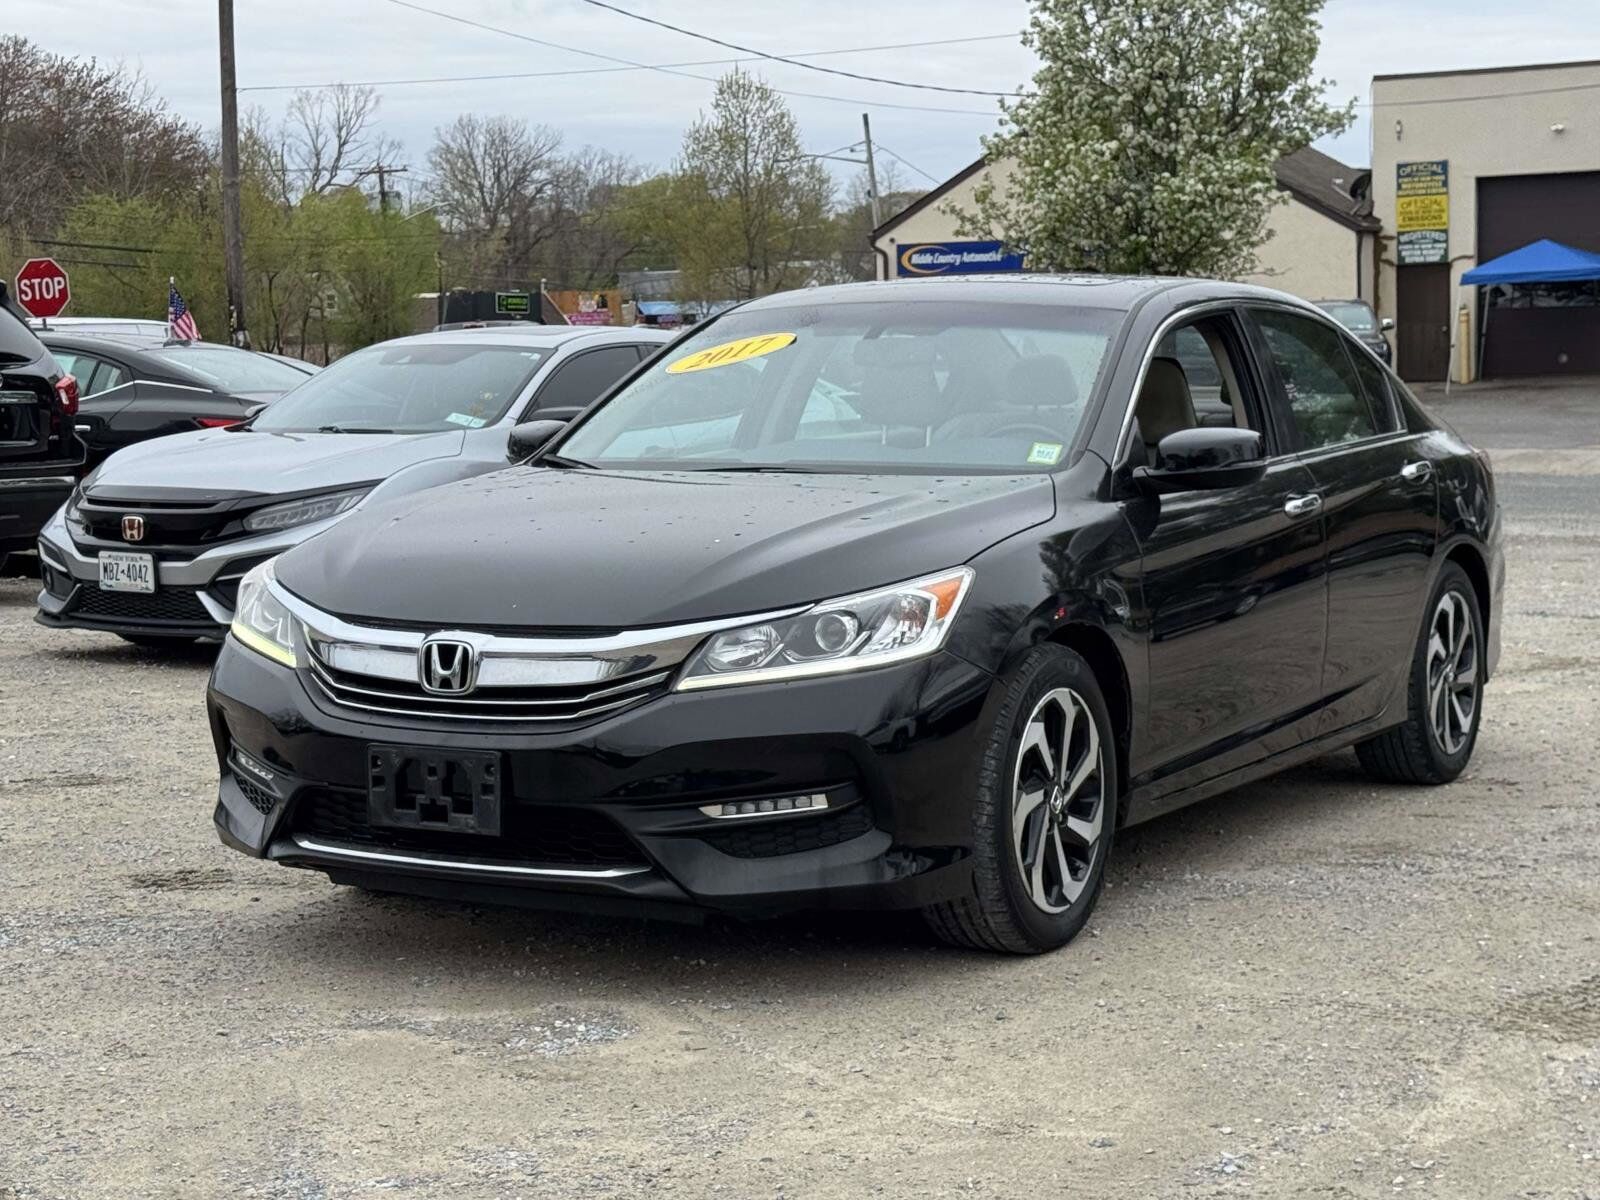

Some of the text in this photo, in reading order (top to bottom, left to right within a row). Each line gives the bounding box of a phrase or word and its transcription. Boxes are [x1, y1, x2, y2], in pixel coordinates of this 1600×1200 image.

[933, 252, 961, 265] Country
[20, 276, 65, 301] STOP
[684, 336, 779, 370] 2017
